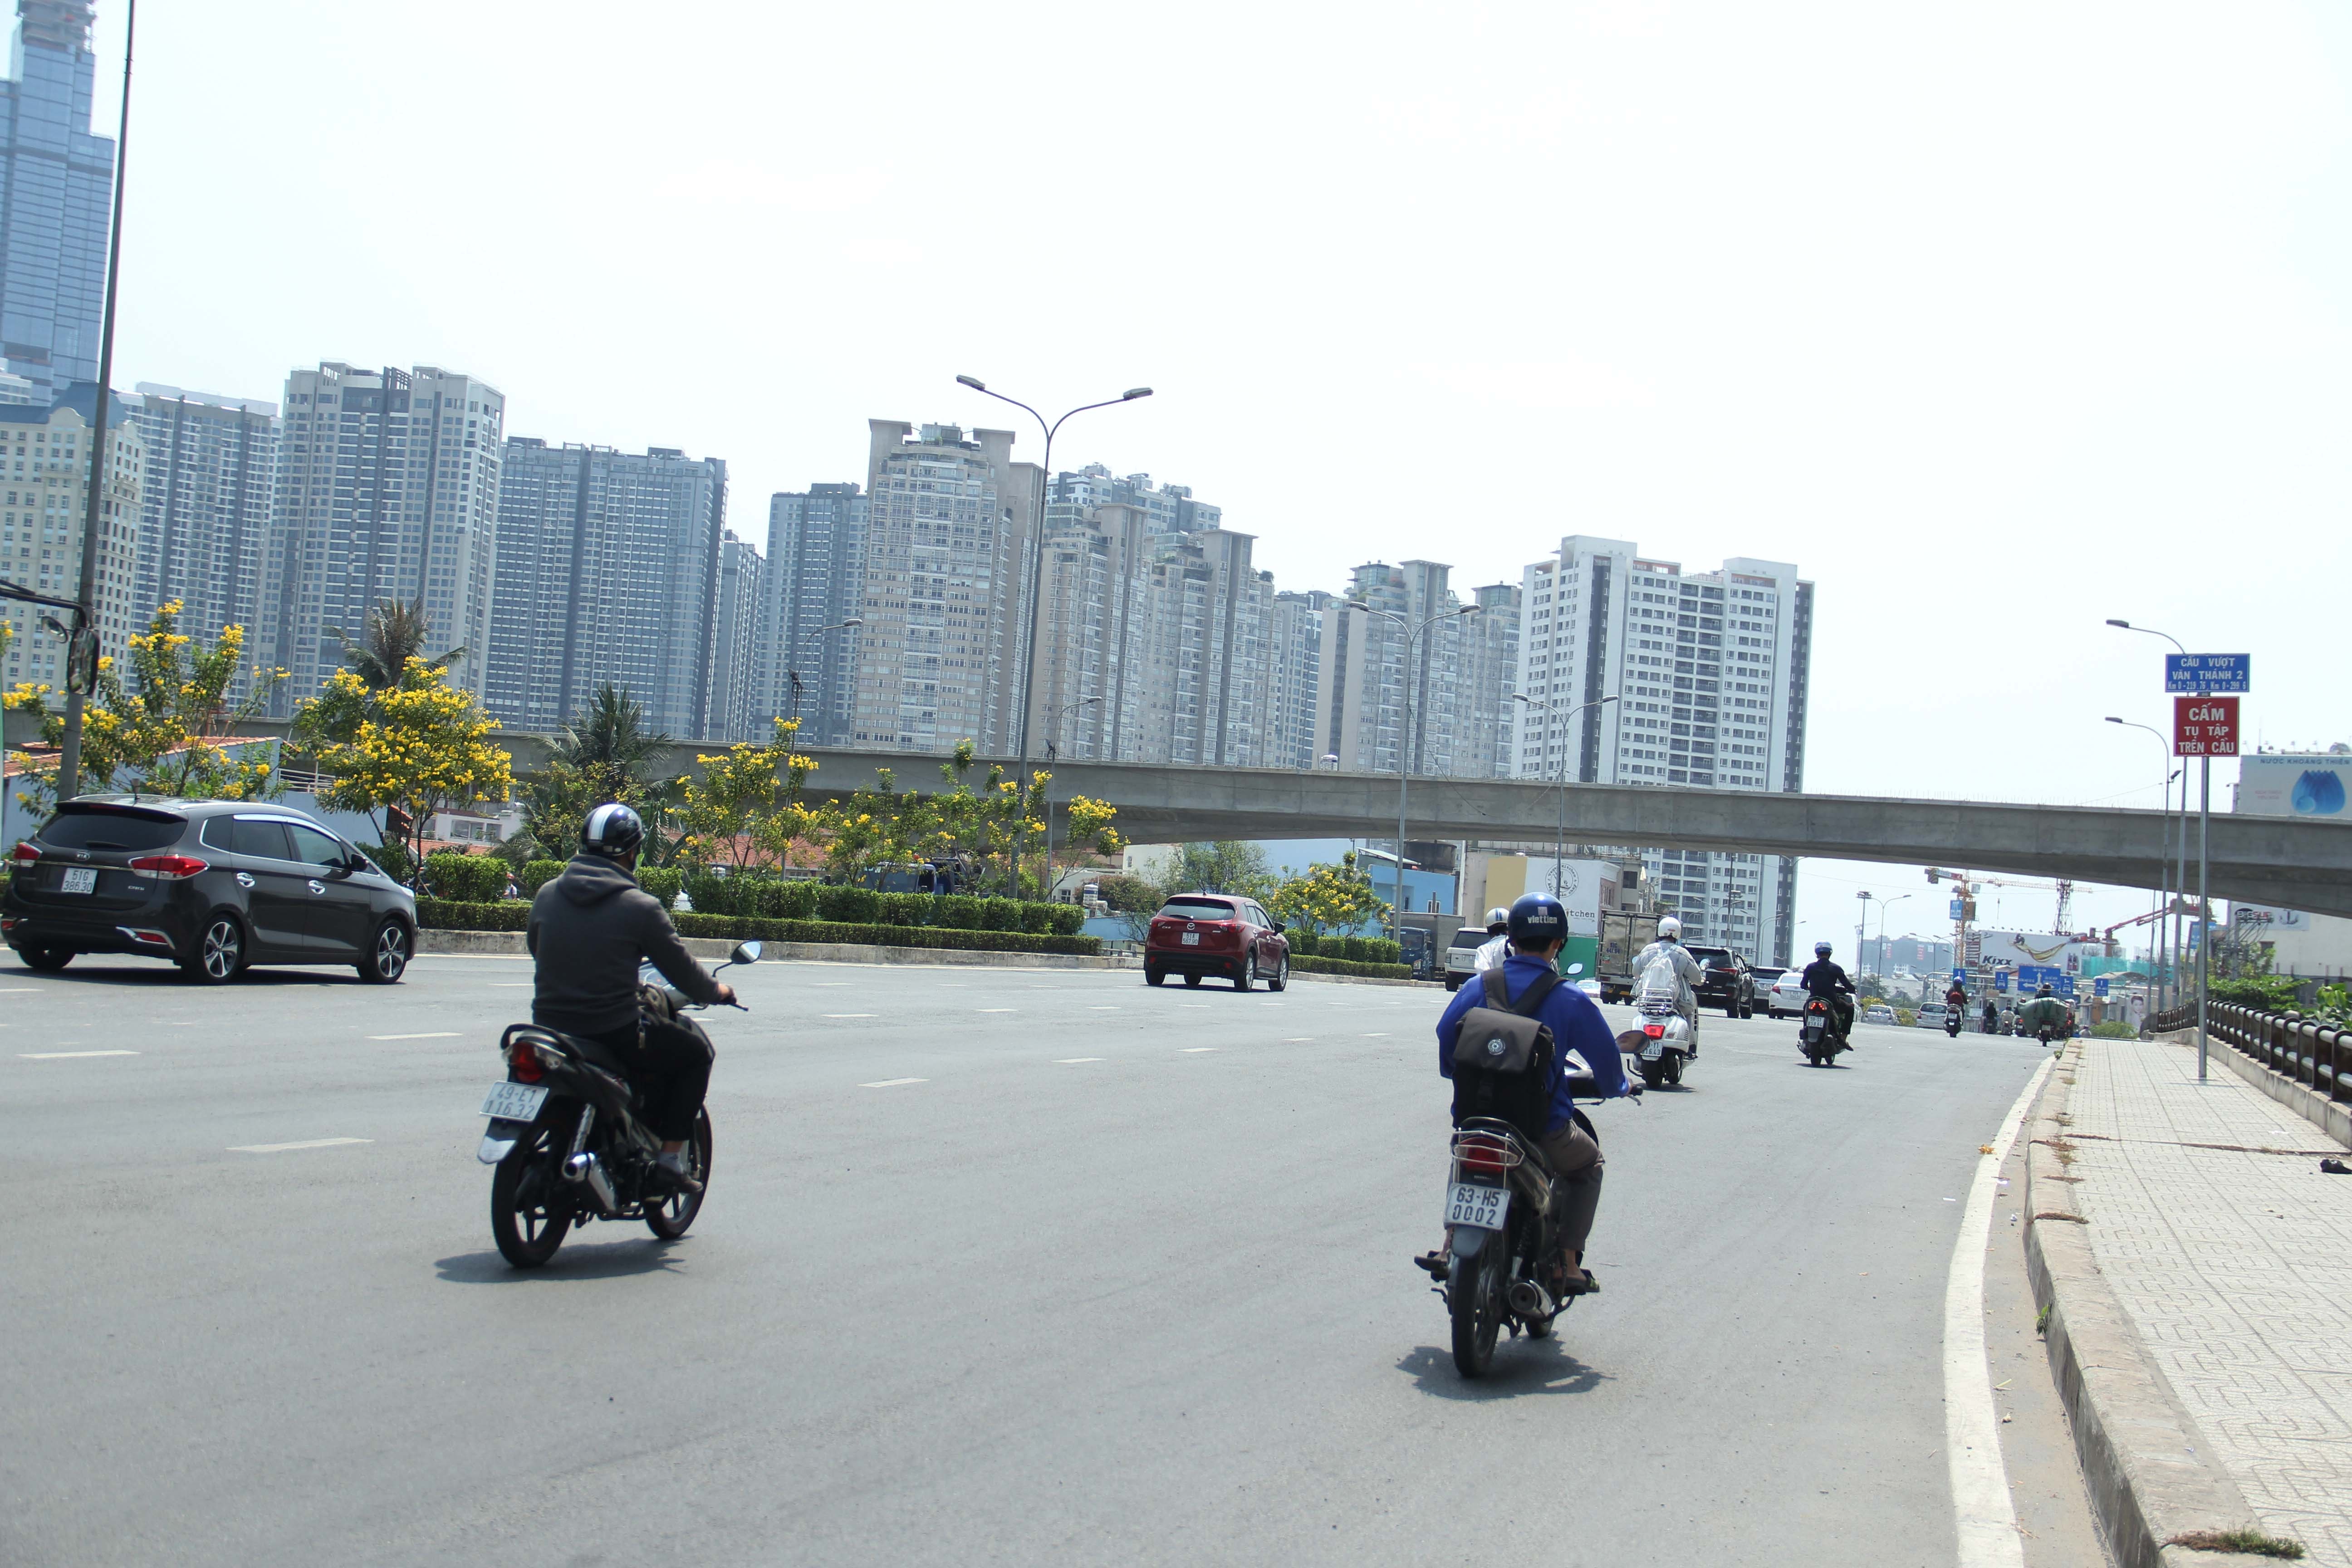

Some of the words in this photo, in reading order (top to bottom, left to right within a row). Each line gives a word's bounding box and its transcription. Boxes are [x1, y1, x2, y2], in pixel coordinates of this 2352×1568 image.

[2180, 656, 2200, 667] CẦU
[2208, 657, 2235, 669] VƯỢT
[2172, 669, 2190, 680] VĂN
[2198, 668, 2231, 680] THÁNH
[2236, 670, 2243, 679] 2
[2188, 702, 2225, 721] CẤM
[2184, 726, 2199, 739] TỤ
[2206, 723, 2229, 739] TẬP
[2178, 739, 2205, 753] TRÊN
[2211, 737, 2234, 753] CẦU
[72, 870, 89, 881] 51G
[1982, 955, 2013, 965] Kixx
[497, 1084, 537, 1103] 49-E1
[1456, 1186, 1501, 1207] 63-H5
[1452, 1204, 1496, 1225] 0002
